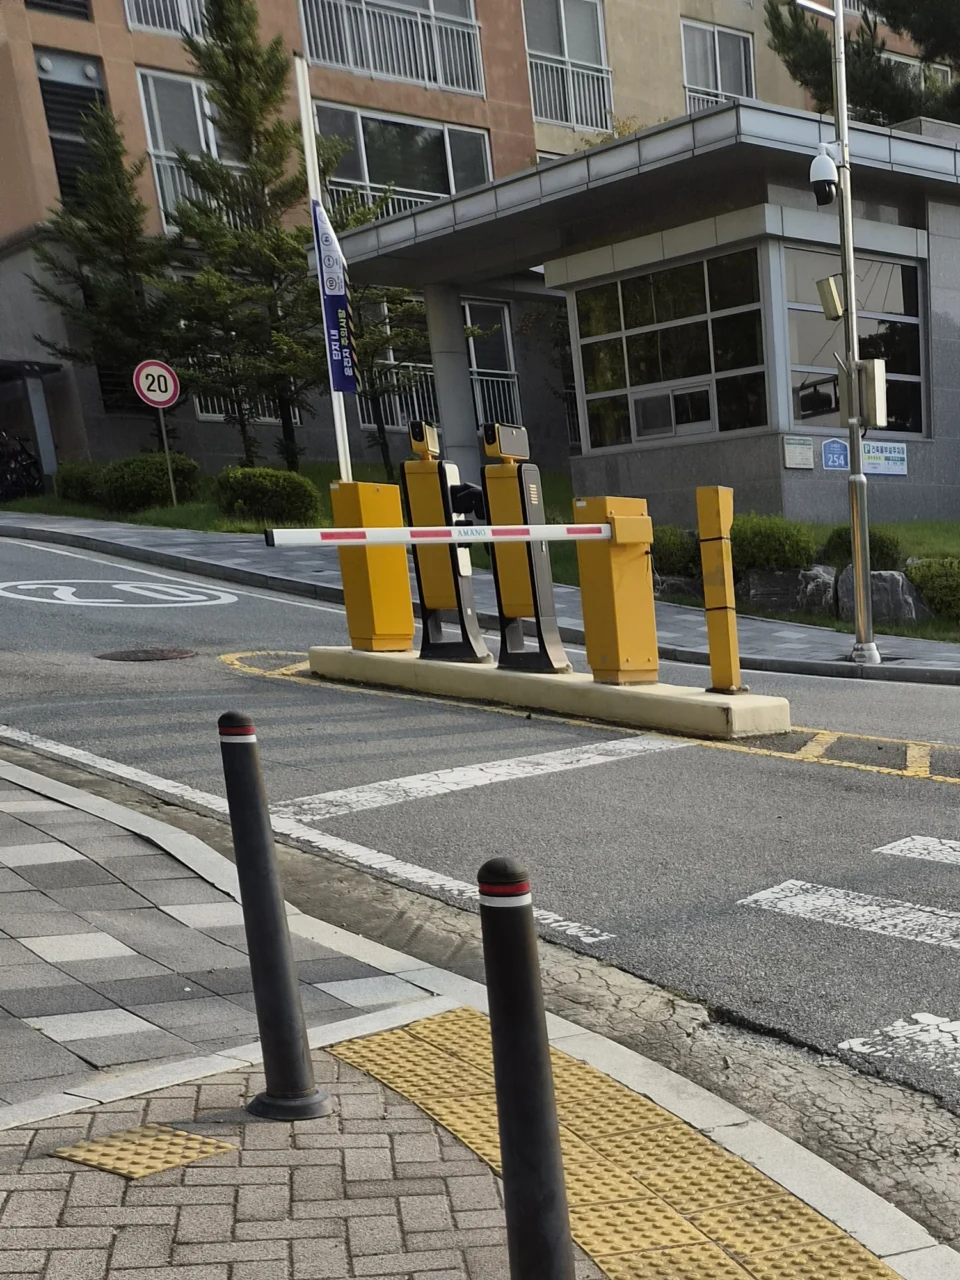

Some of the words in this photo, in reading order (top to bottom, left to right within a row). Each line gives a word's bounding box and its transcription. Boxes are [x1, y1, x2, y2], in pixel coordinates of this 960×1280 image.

[329, 329, 340, 339] 내
[337, 308, 349, 346] 주의사항
[331, 341, 341, 360] 단지
[342, 348, 354, 377] 운전자
[145, 373, 168, 393] 20
[827, 454, 845, 466] 254
[457, 528, 486, 537] AMANO
[17, 584, 208, 603] 20
